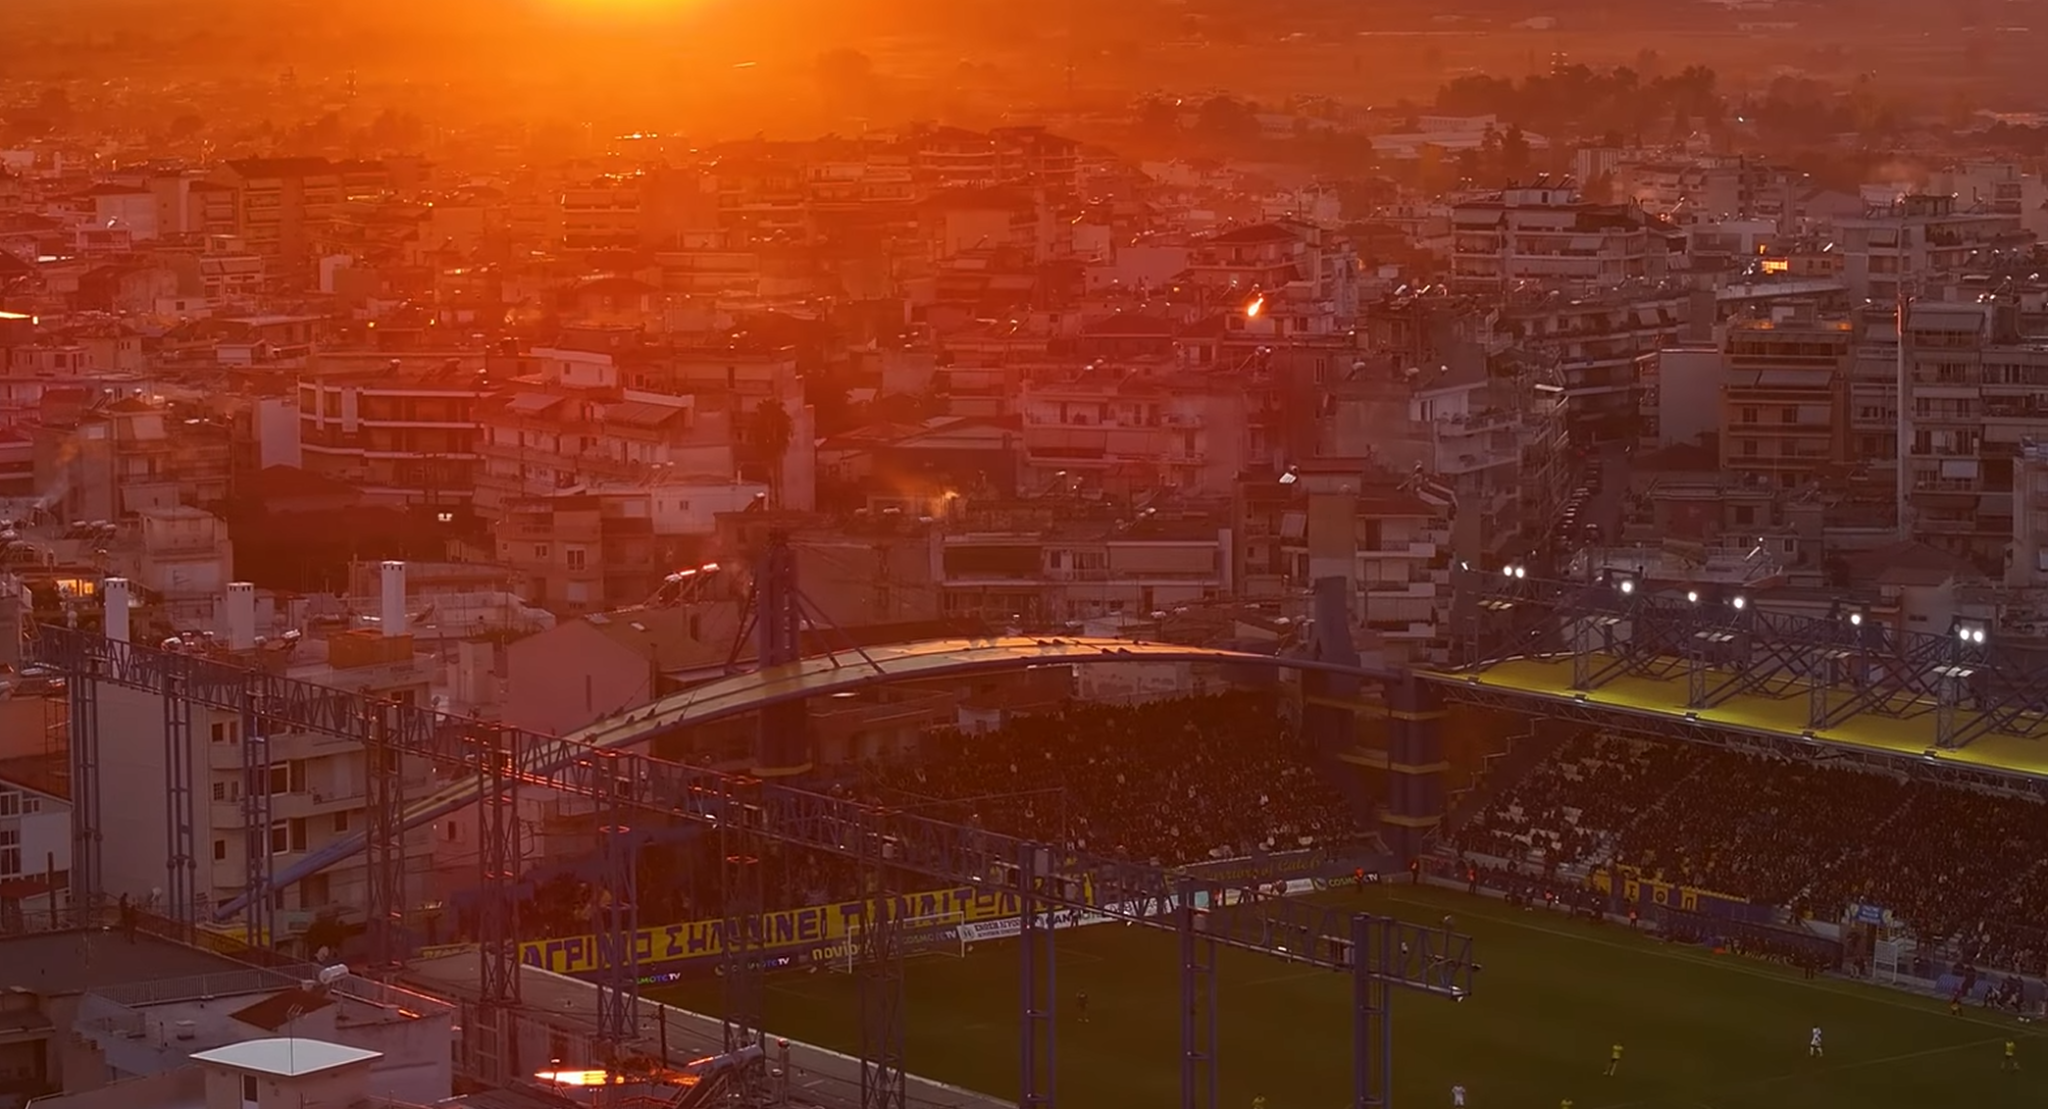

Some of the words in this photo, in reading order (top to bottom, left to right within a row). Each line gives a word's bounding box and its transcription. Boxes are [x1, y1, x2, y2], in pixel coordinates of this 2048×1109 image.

[1367, 873, 1378, 882] TV
[945, 929, 957, 940] TV
[777, 957, 790, 966] TV
[668, 972, 681, 981] TV
